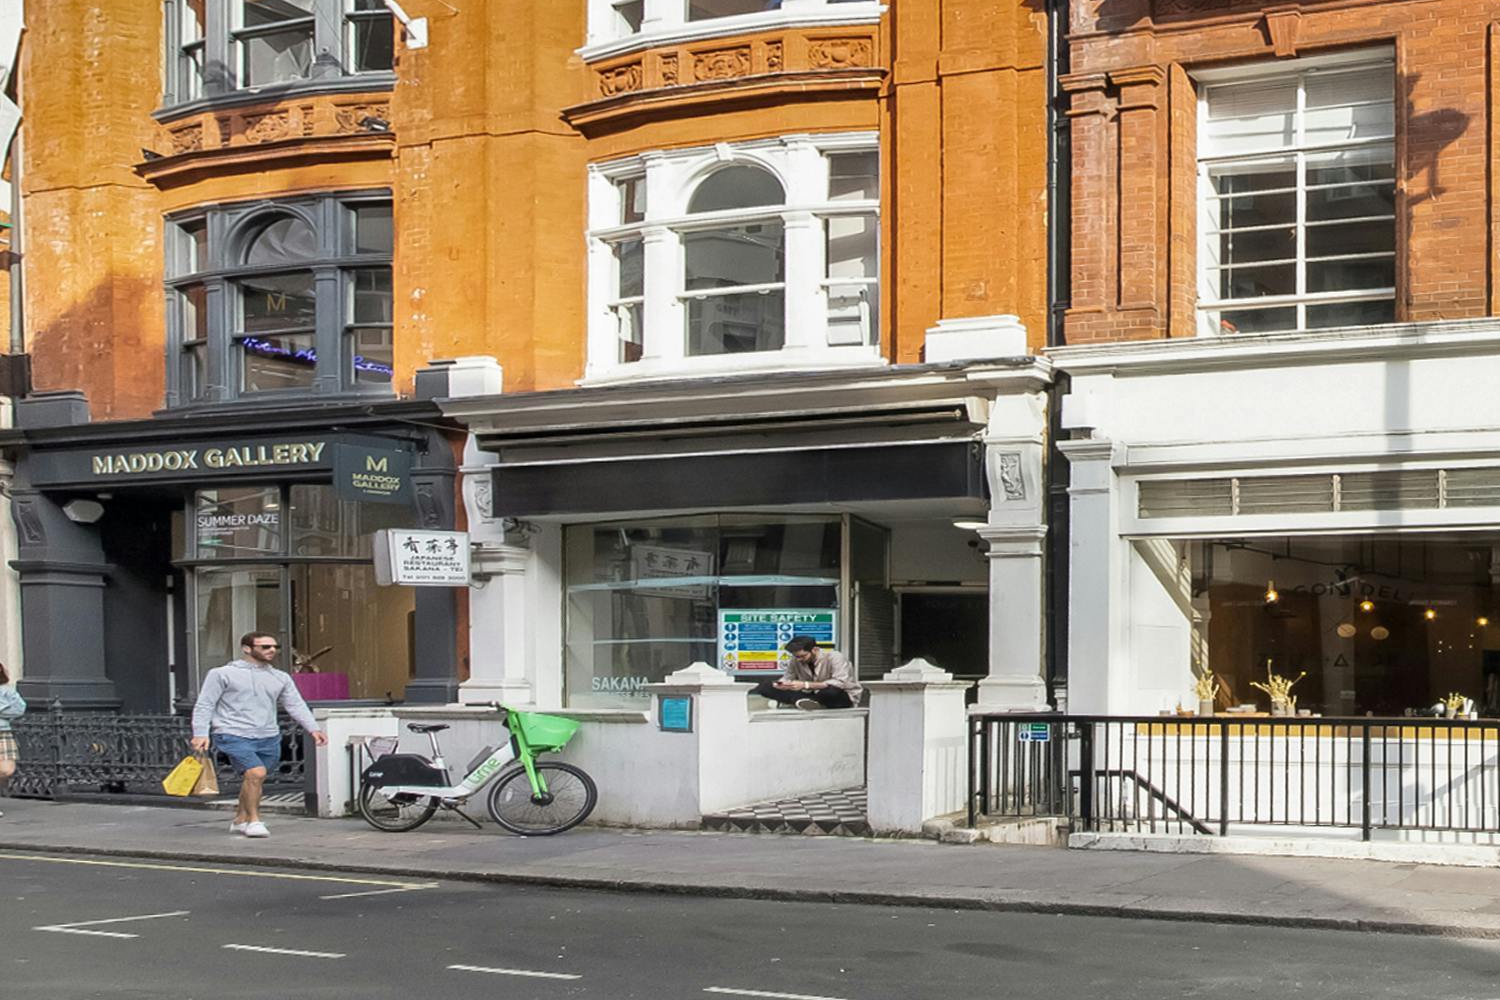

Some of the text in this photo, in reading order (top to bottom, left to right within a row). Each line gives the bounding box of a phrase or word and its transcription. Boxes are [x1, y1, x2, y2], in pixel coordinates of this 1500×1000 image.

[92, 442, 325, 474] MADDOX GALLERY
[367, 456, 387, 472] M
[352, 473, 400, 483] MADDOX
[352, 480, 400, 491] GALLERY
[198, 513, 279, 527] SUMMER DAZE
[741, 614, 817, 622] SITE SAFETY
[592, 676, 649, 690] SAKANA
